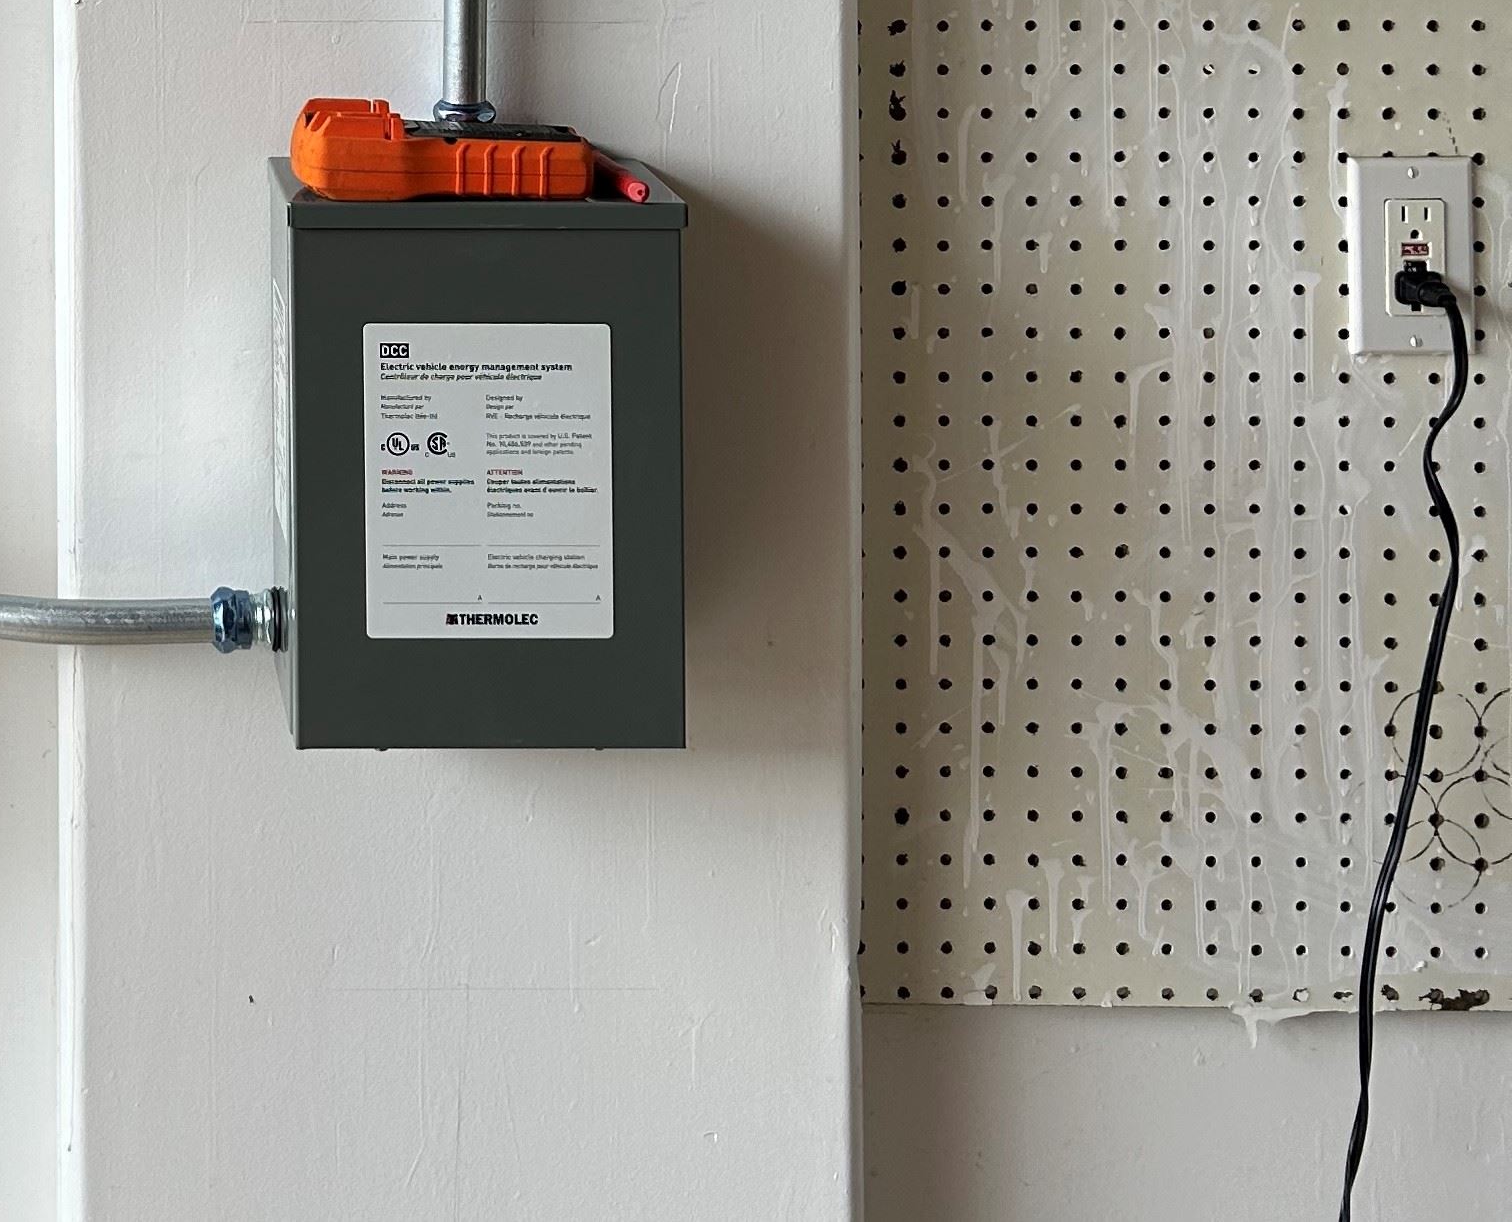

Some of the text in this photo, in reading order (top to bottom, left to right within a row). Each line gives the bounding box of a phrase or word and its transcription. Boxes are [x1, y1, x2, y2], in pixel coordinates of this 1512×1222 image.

[381, 345, 408, 357] DCC
[381, 363, 573, 373] Electric vehicle energy management system
[431, 373, 455, 382] charge
[456, 374, 474, 382] pour
[459, 613, 539, 626] THERMOLEC
